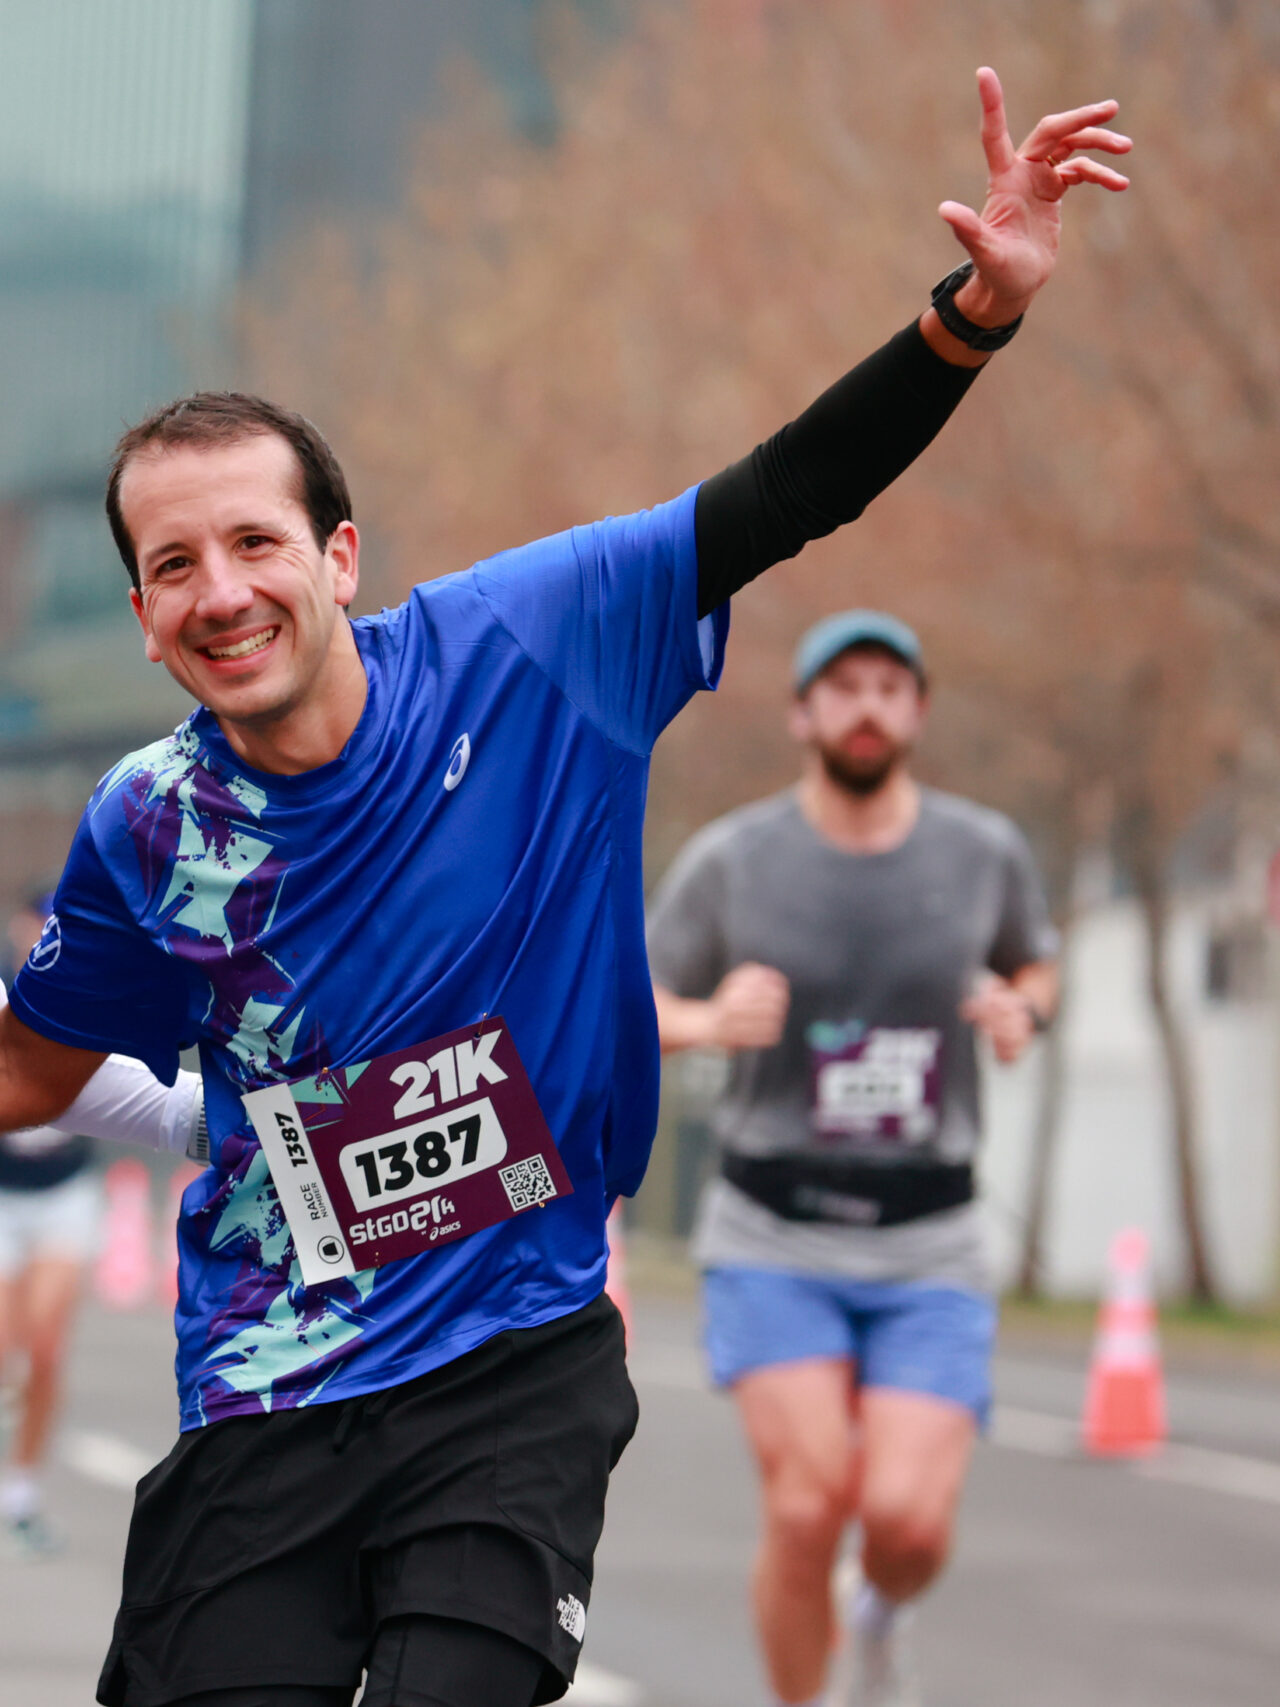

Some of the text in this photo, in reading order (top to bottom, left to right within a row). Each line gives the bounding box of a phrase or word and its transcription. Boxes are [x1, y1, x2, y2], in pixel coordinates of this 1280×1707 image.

[389, 1028, 509, 1120] 21K
[274, 1112, 309, 1168] 1387
[355, 1113, 481, 1198] 1387
[300, 1183, 320, 1220] RACE
[311, 1182, 329, 1218] NUMBER
